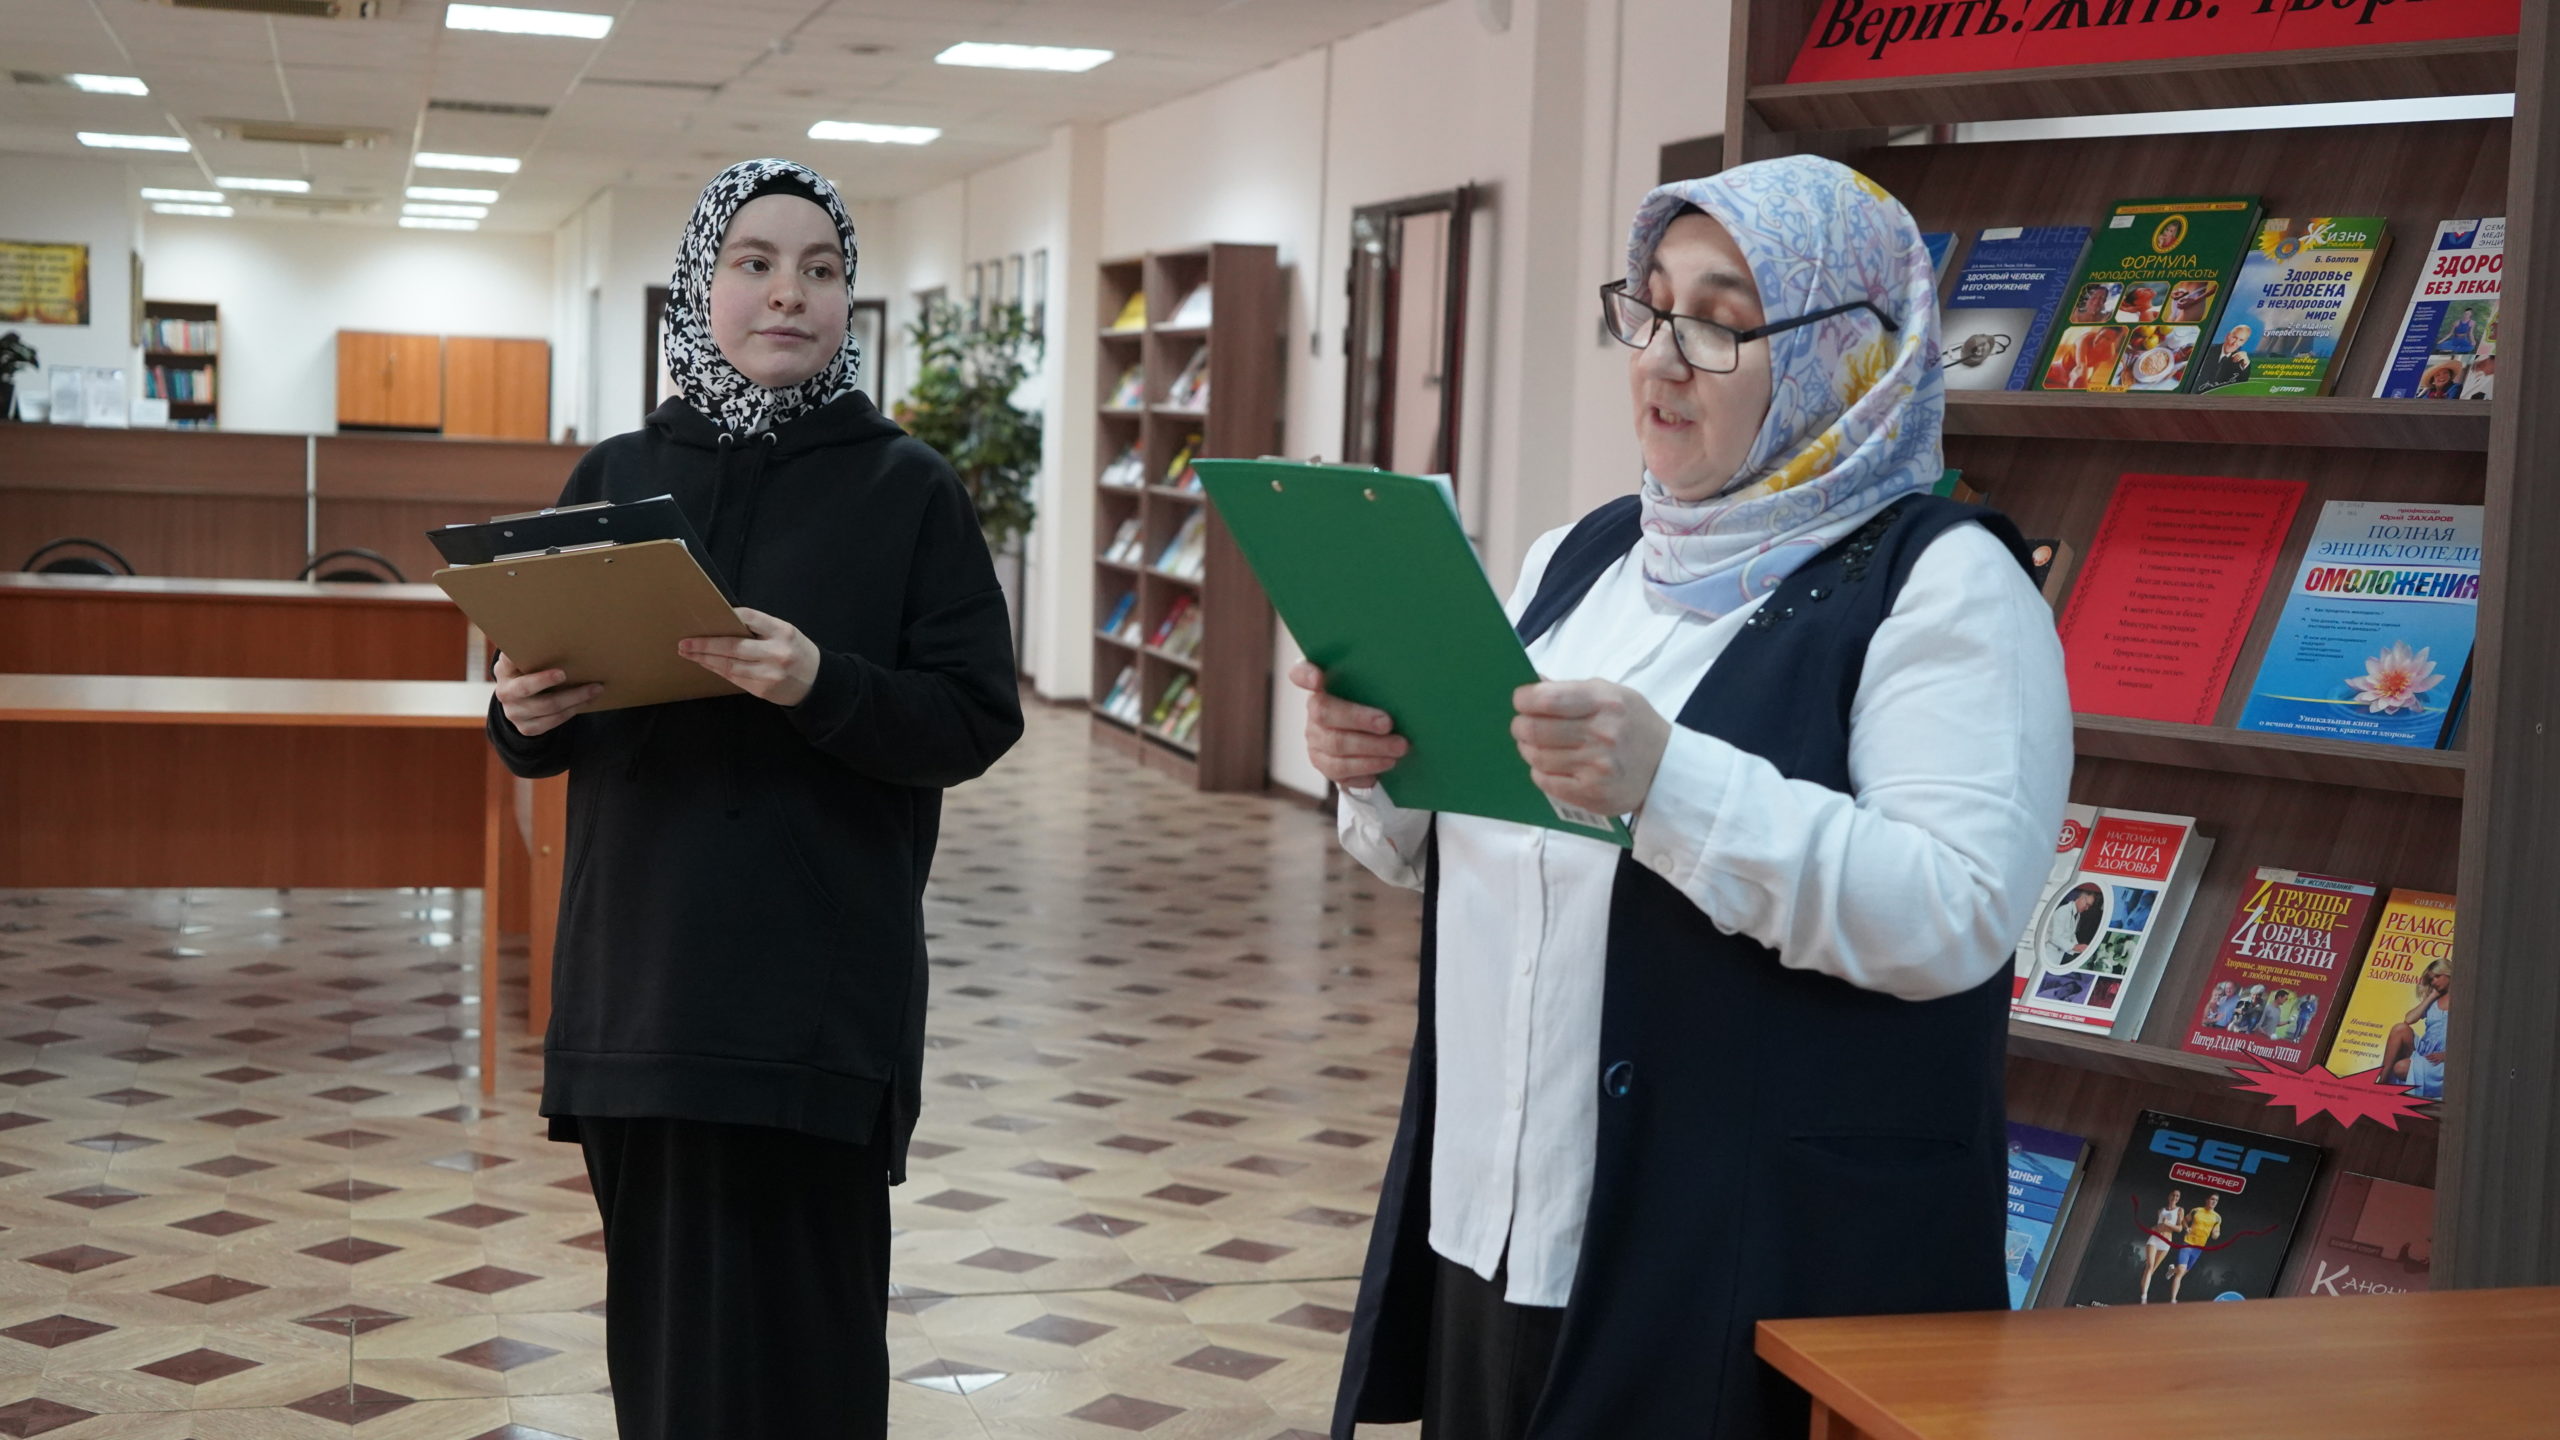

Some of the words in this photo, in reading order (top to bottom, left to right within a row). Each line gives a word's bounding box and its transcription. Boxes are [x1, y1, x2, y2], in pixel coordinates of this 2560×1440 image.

[2121, 254, 2197, 270] ФОРМУЛА
[2433, 254, 2504, 278] ЗДОРО
[1966, 273, 2010, 281] ЗДОРОВЫЙ
[2010, 273, 2046, 281] ЧЕЛОВЕК
[2089, 270, 2155, 280] МОЛОДОСТИ
[2156, 270, 2166, 279] И
[2167, 269, 2220, 279] КРАСОТЫ
[2284, 269, 2353, 283] Здоровье
[1983, 283, 2032, 291] ОКРУЖЕНИЕ
[2263, 284, 2346, 298] ЧЕЛОВЕКА
[2424, 281, 2453, 295] БЕЗ
[2257, 300, 2264, 308] в
[2268, 300, 2341, 310] нездоровом
[2305, 311, 2337, 322] мире
[2368, 525, 2456, 542] ПОЛНАЯ
[2318, 541, 2481, 563] ЭНЦИКЛОПЕДИ
[2305, 567, 2480, 600] ОМОЛОЖЕНИЯ
[2299, 714, 2350, 724] Уникальная
[2107, 831, 2168, 845] НАСТОЛЬНАЯ
[2100, 840, 2160, 863] КНИГА
[2095, 857, 2158, 874] ЗДОРОВЬЯ
[2243, 881, 2274, 924] 4
[2275, 888, 2352, 915] ГРУППЫ
[2231, 905, 2266, 956] 4
[2262, 923, 2331, 950] ОБРАЗА
[2254, 941, 2338, 969] ЖИЗНИ
[2371, 951, 2414, 971] БЫТЬ
[2191, 1031, 2214, 1050] Питер
[2149, 1128, 2290, 1174] БЕГ
[2176, 1167, 2240, 1188] КНИГА-ТРЕНЕР
